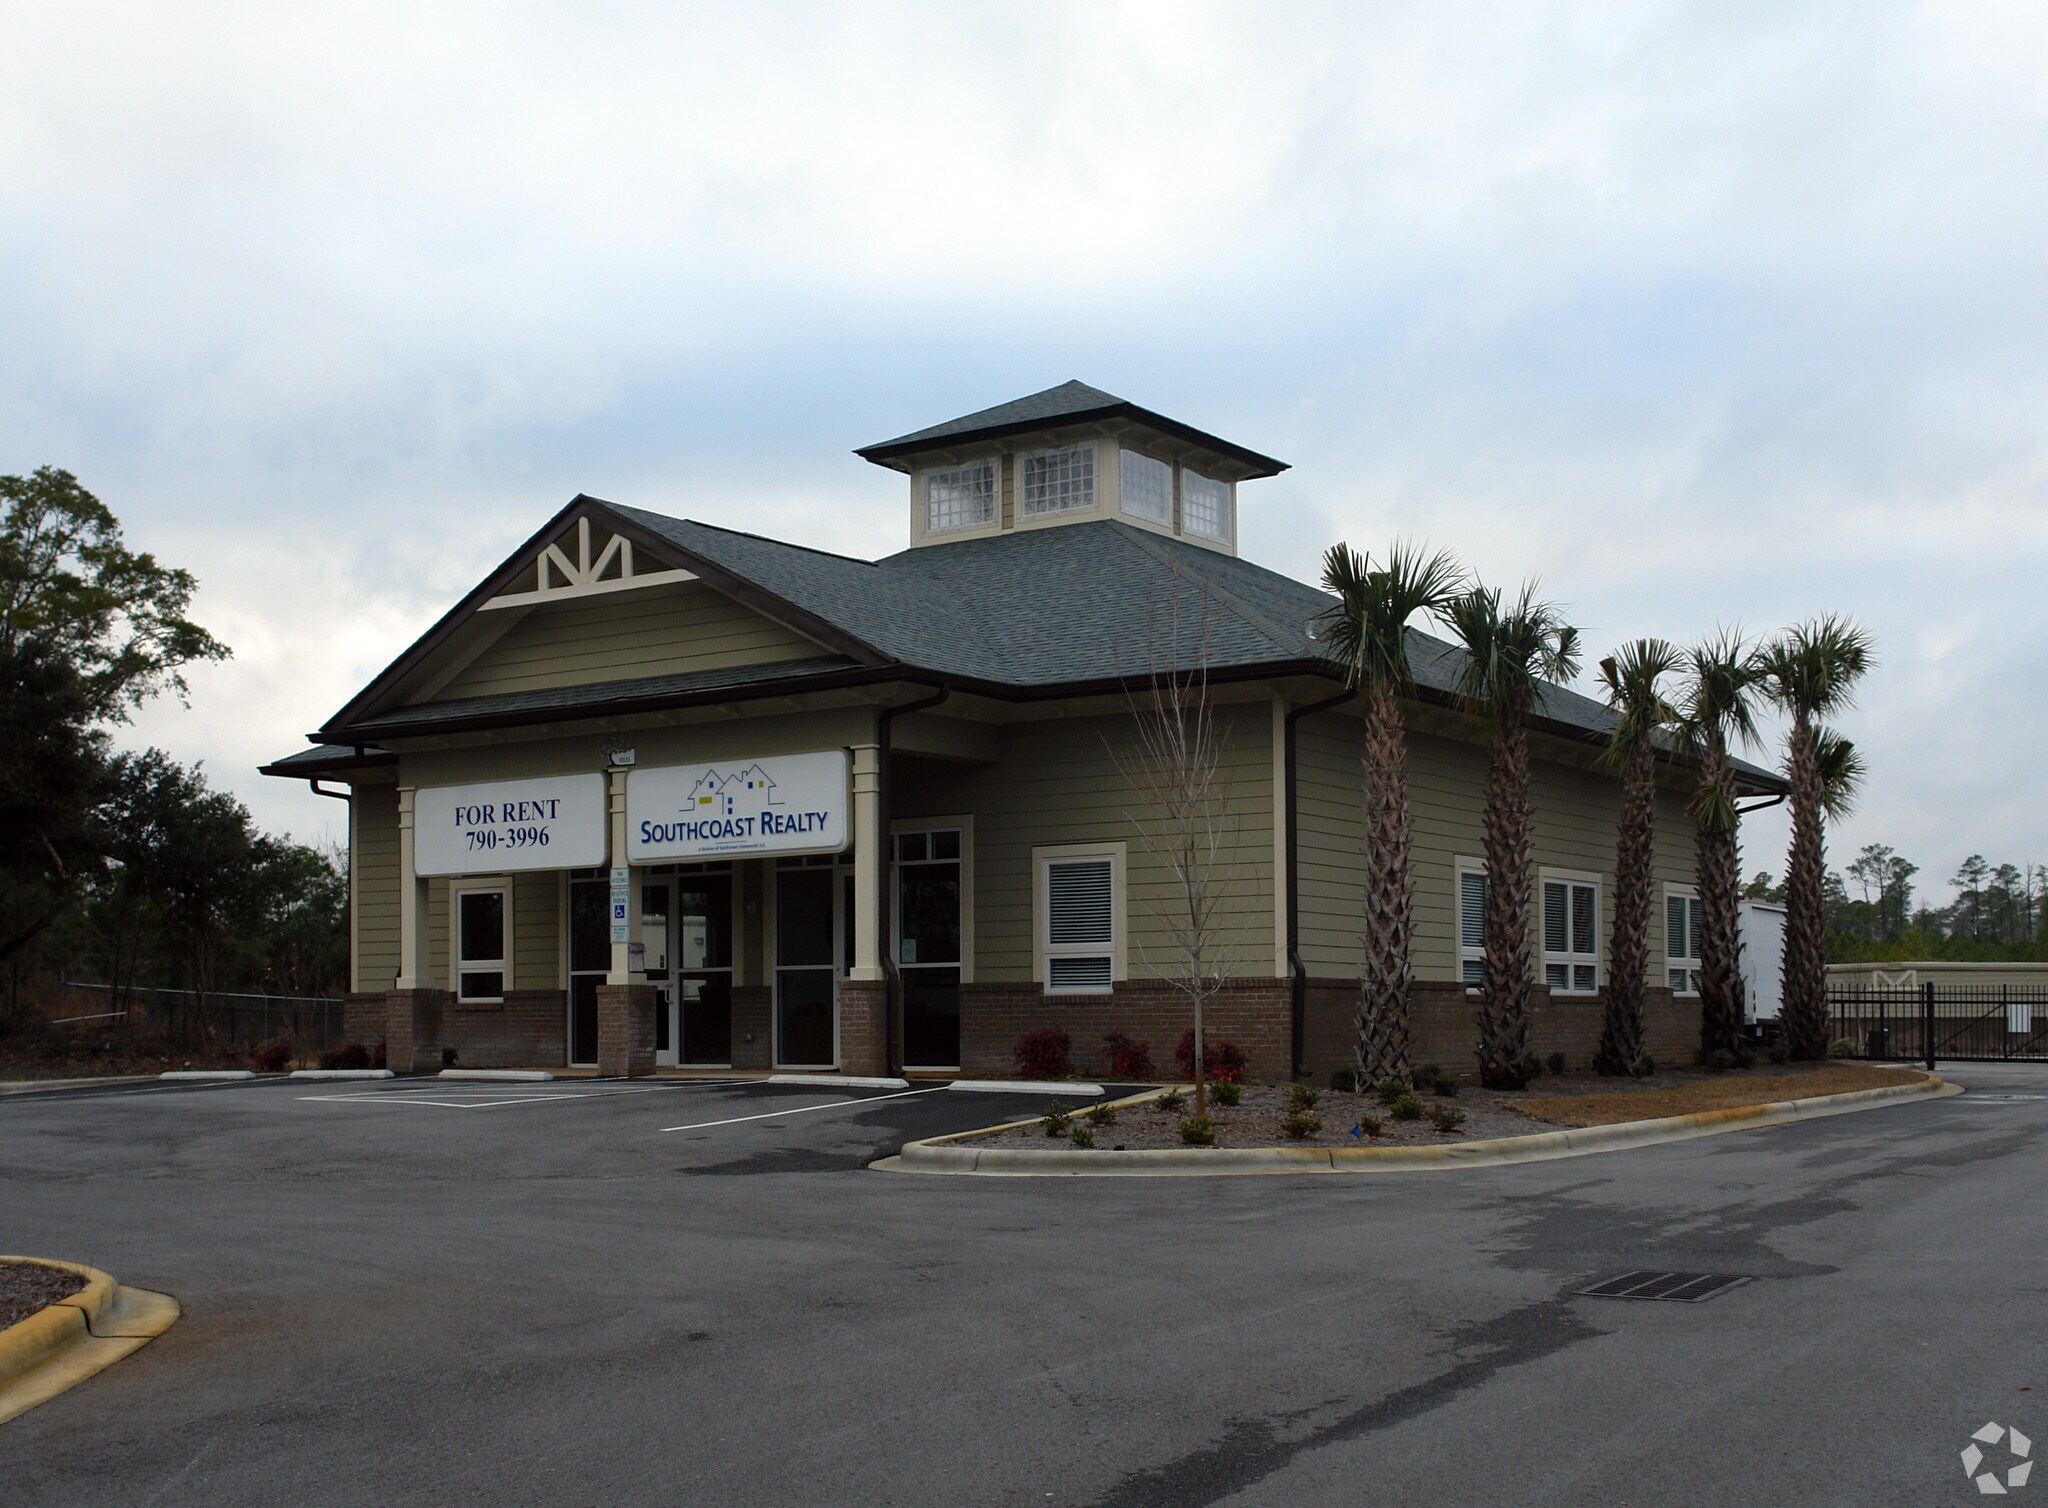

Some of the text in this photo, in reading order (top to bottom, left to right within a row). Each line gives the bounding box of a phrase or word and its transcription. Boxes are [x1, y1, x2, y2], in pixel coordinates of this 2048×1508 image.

[454, 799, 560, 827] FOR RENT
[466, 826, 550, 851] 790-3996
[640, 811, 829, 844] SOUTHCOAST REALTY
